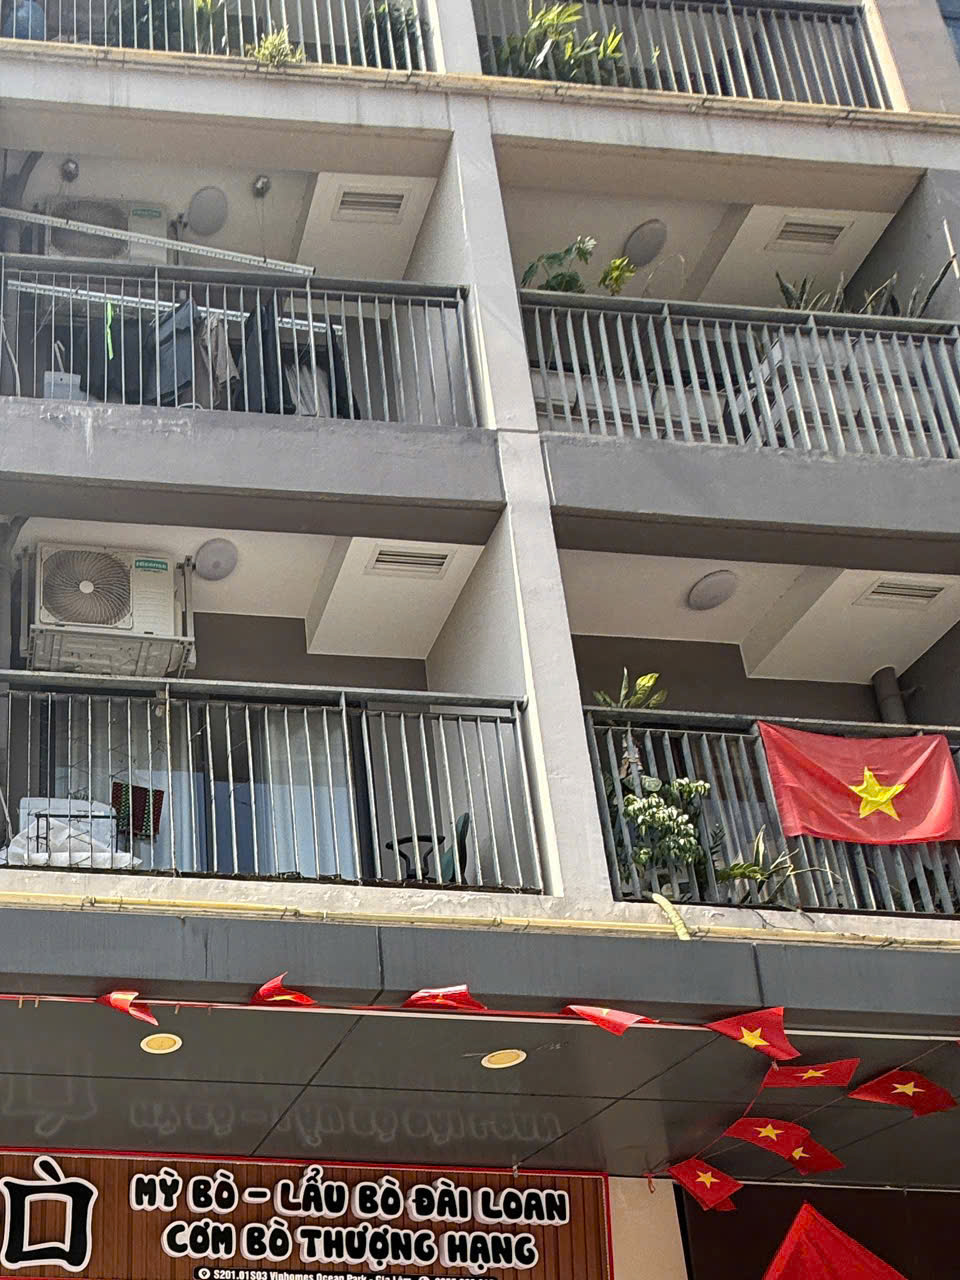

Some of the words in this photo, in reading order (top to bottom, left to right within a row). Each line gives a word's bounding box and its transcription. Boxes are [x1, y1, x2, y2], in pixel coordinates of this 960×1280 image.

[187, 1169, 239, 1214] BÒ
[242, 1187, 271, 1203] -
[274, 1164, 348, 1218] LẨU
[351, 1175, 404, 1220] BÒ
[405, 1177, 471, 1223] ĐÀI
[474, 1187, 569, 1226] LOAN
[161, 1218, 236, 1259] CƠM
[240, 1216, 292, 1262] BÒ
[295, 1222, 438, 1272] THƯỢNG
[440, 1231, 539, 1275] HẠNG
[213, 1269, 267, 1280] S201.01S03
